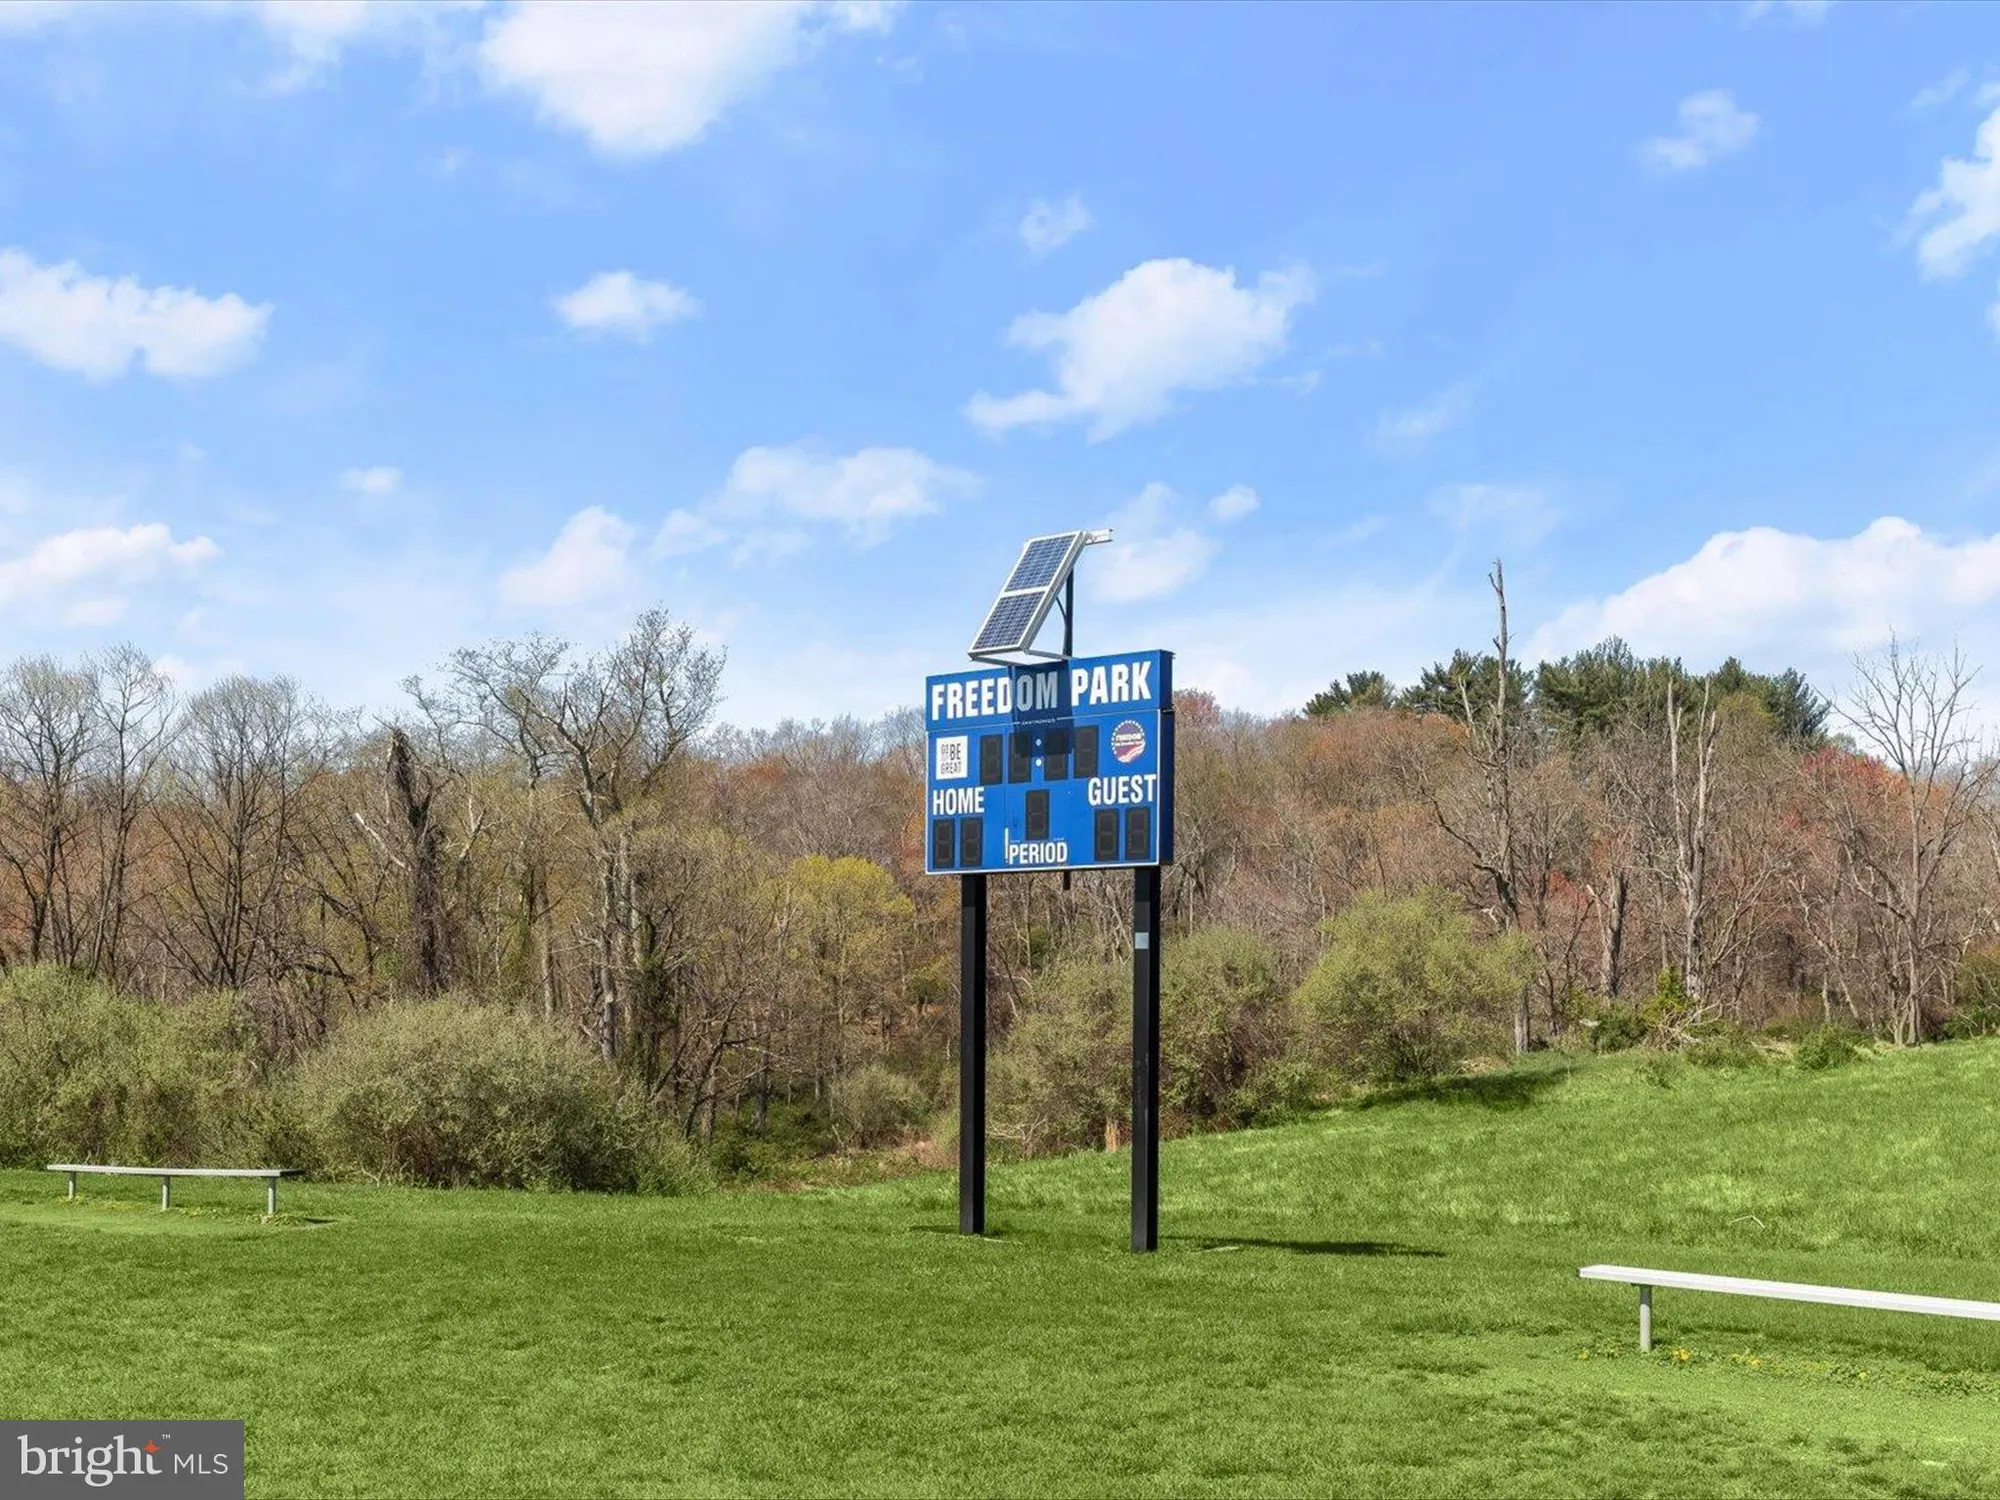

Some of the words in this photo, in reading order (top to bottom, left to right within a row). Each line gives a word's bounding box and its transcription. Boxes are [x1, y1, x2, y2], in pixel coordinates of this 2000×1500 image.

[931, 671, 1058, 721] FREEDOM
[1071, 660, 1152, 707] PARK
[949, 743, 961, 761] BE
[940, 761, 962, 775] GREAT
[932, 787, 985, 816] HOME
[1088, 774, 1157, 806] GUEST
[1009, 841, 1068, 865] PERIOD
